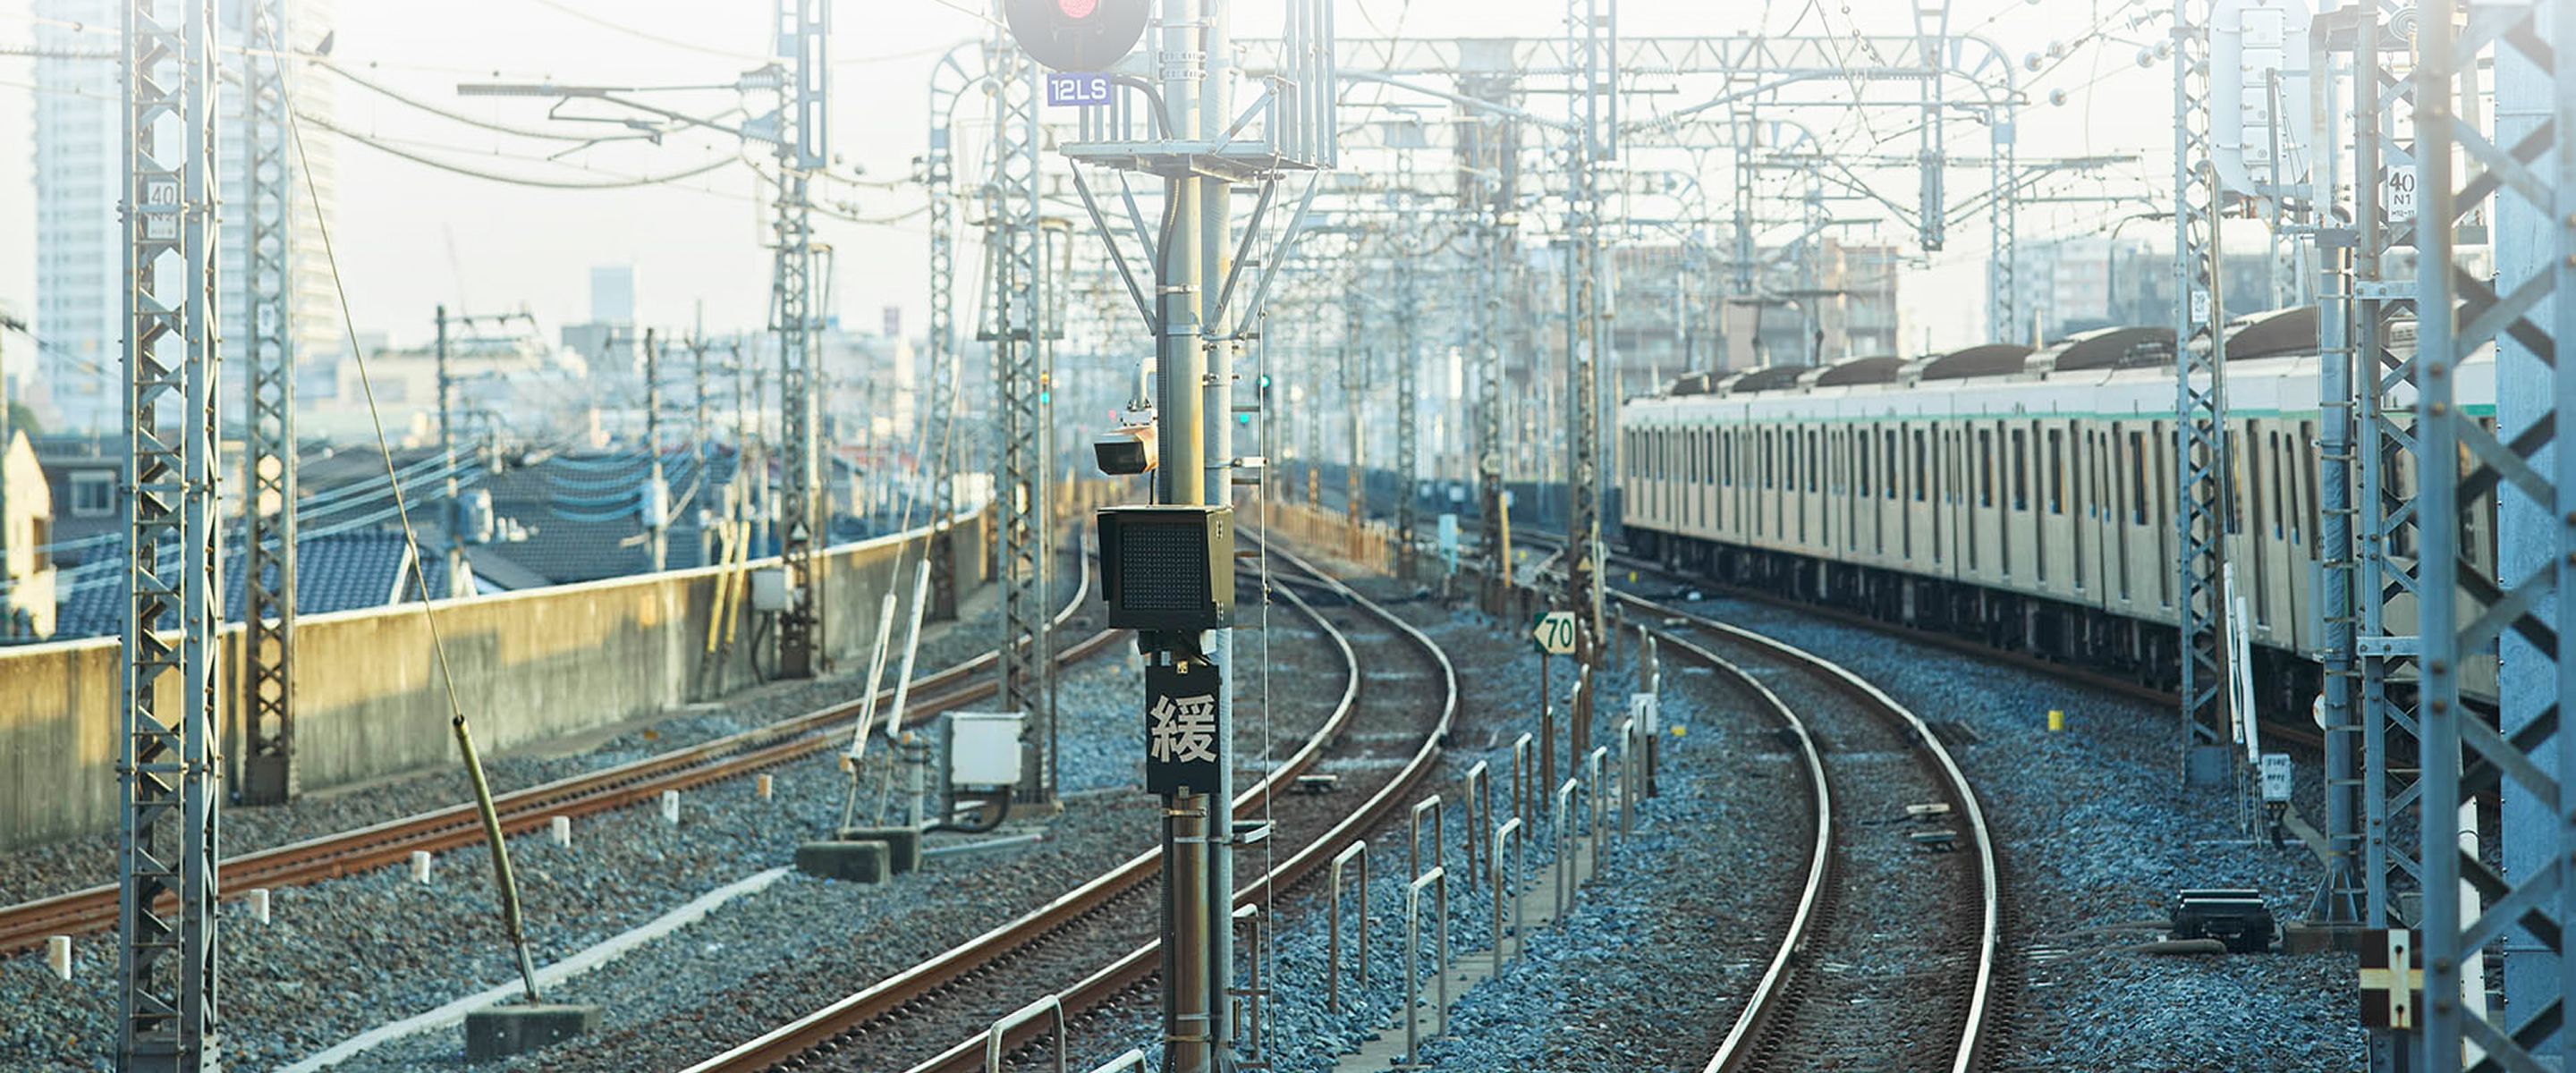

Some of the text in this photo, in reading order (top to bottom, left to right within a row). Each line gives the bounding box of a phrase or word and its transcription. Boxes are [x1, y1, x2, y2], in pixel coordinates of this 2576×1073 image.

[1051, 79, 1106, 101] 12LS
[2389, 172, 2415, 192] 40
[151, 185, 174, 205] 40
[2394, 194, 2411, 205] N1
[1546, 618, 1573, 648] 70
[1149, 694, 1217, 764] 緩
